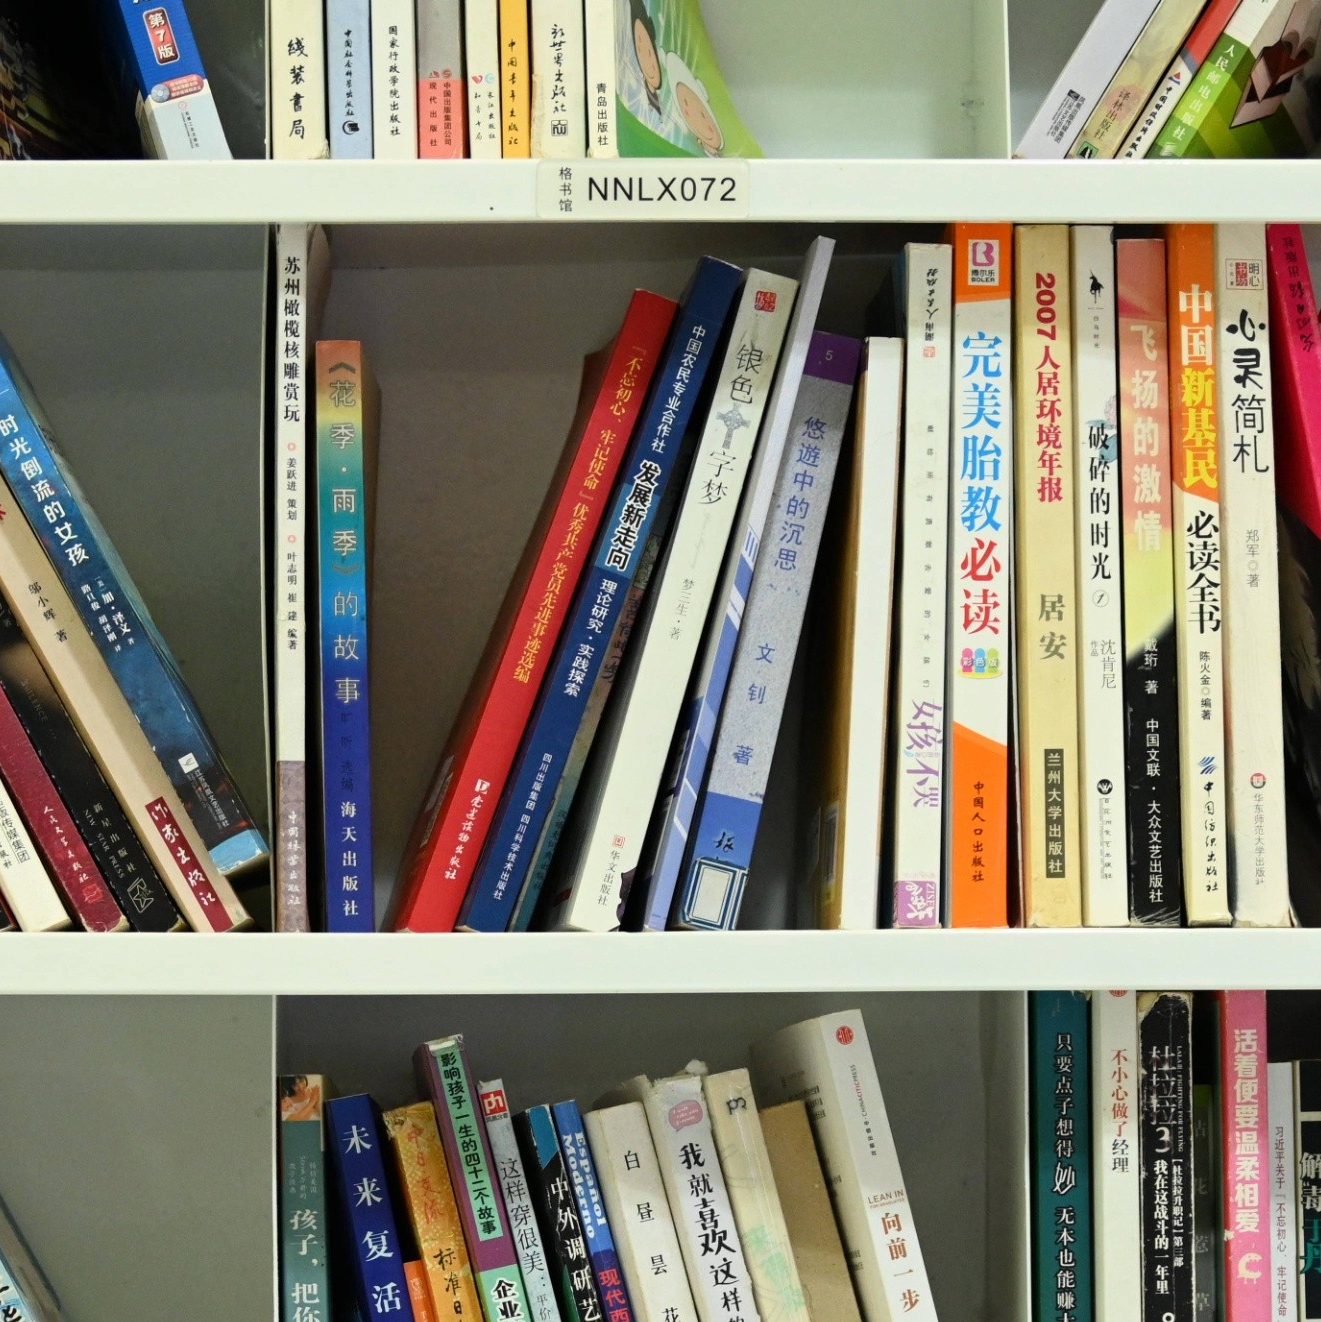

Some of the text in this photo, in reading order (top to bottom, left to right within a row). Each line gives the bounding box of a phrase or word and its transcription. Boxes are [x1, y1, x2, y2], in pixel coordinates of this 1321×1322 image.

[147, 12, 176, 60] 第7版
[1174, 46, 1237, 143] 人民邮电出版社
[596, 83, 609, 147] 青岛出版社
[558, 166, 573, 212] 格书馆
[588, 177, 737, 203] NNLX072
[283, 256, 301, 422] 苏州橄榄核雕赏玩
[651, 325, 707, 455] 中国农民专业合作社
[1035, 272, 1063, 503] 2007 人居环境年报
[1179, 284, 1218, 489] 中国新基民
[960, 331, 1002, 635] 完美胎教必读
[1131, 323, 1161, 551] 飞扬的激情
[607, 459, 661, 570] 发展新走向
[1088, 424, 1111, 580] 破碎的时光
[1038, 594, 1067, 660] 居安
[341, 801, 358, 917] 海天出版社
[1047, 752, 1063, 874] 兰州大学出版社
[597, 850, 621, 906] 华文出版社
[441, 1053, 496, 1235] 影响孩子一生的四十二个故事
[1052, 1033, 1075, 1195] 只要点子想得妙
[1111, 1048, 1129, 1173] 不小心做了经理
[1234, 1029, 1261, 1234] 活着便要温柔相爱
[342, 1125, 402, 1314] 未来复活
[562, 1135, 595, 1239] Moderno
[868, 1190, 904, 1204] LEAN IN
[1154, 1160, 1170, 1295] 我在这战斗的一年里
[880, 1212, 920, 1313] 向前一步
